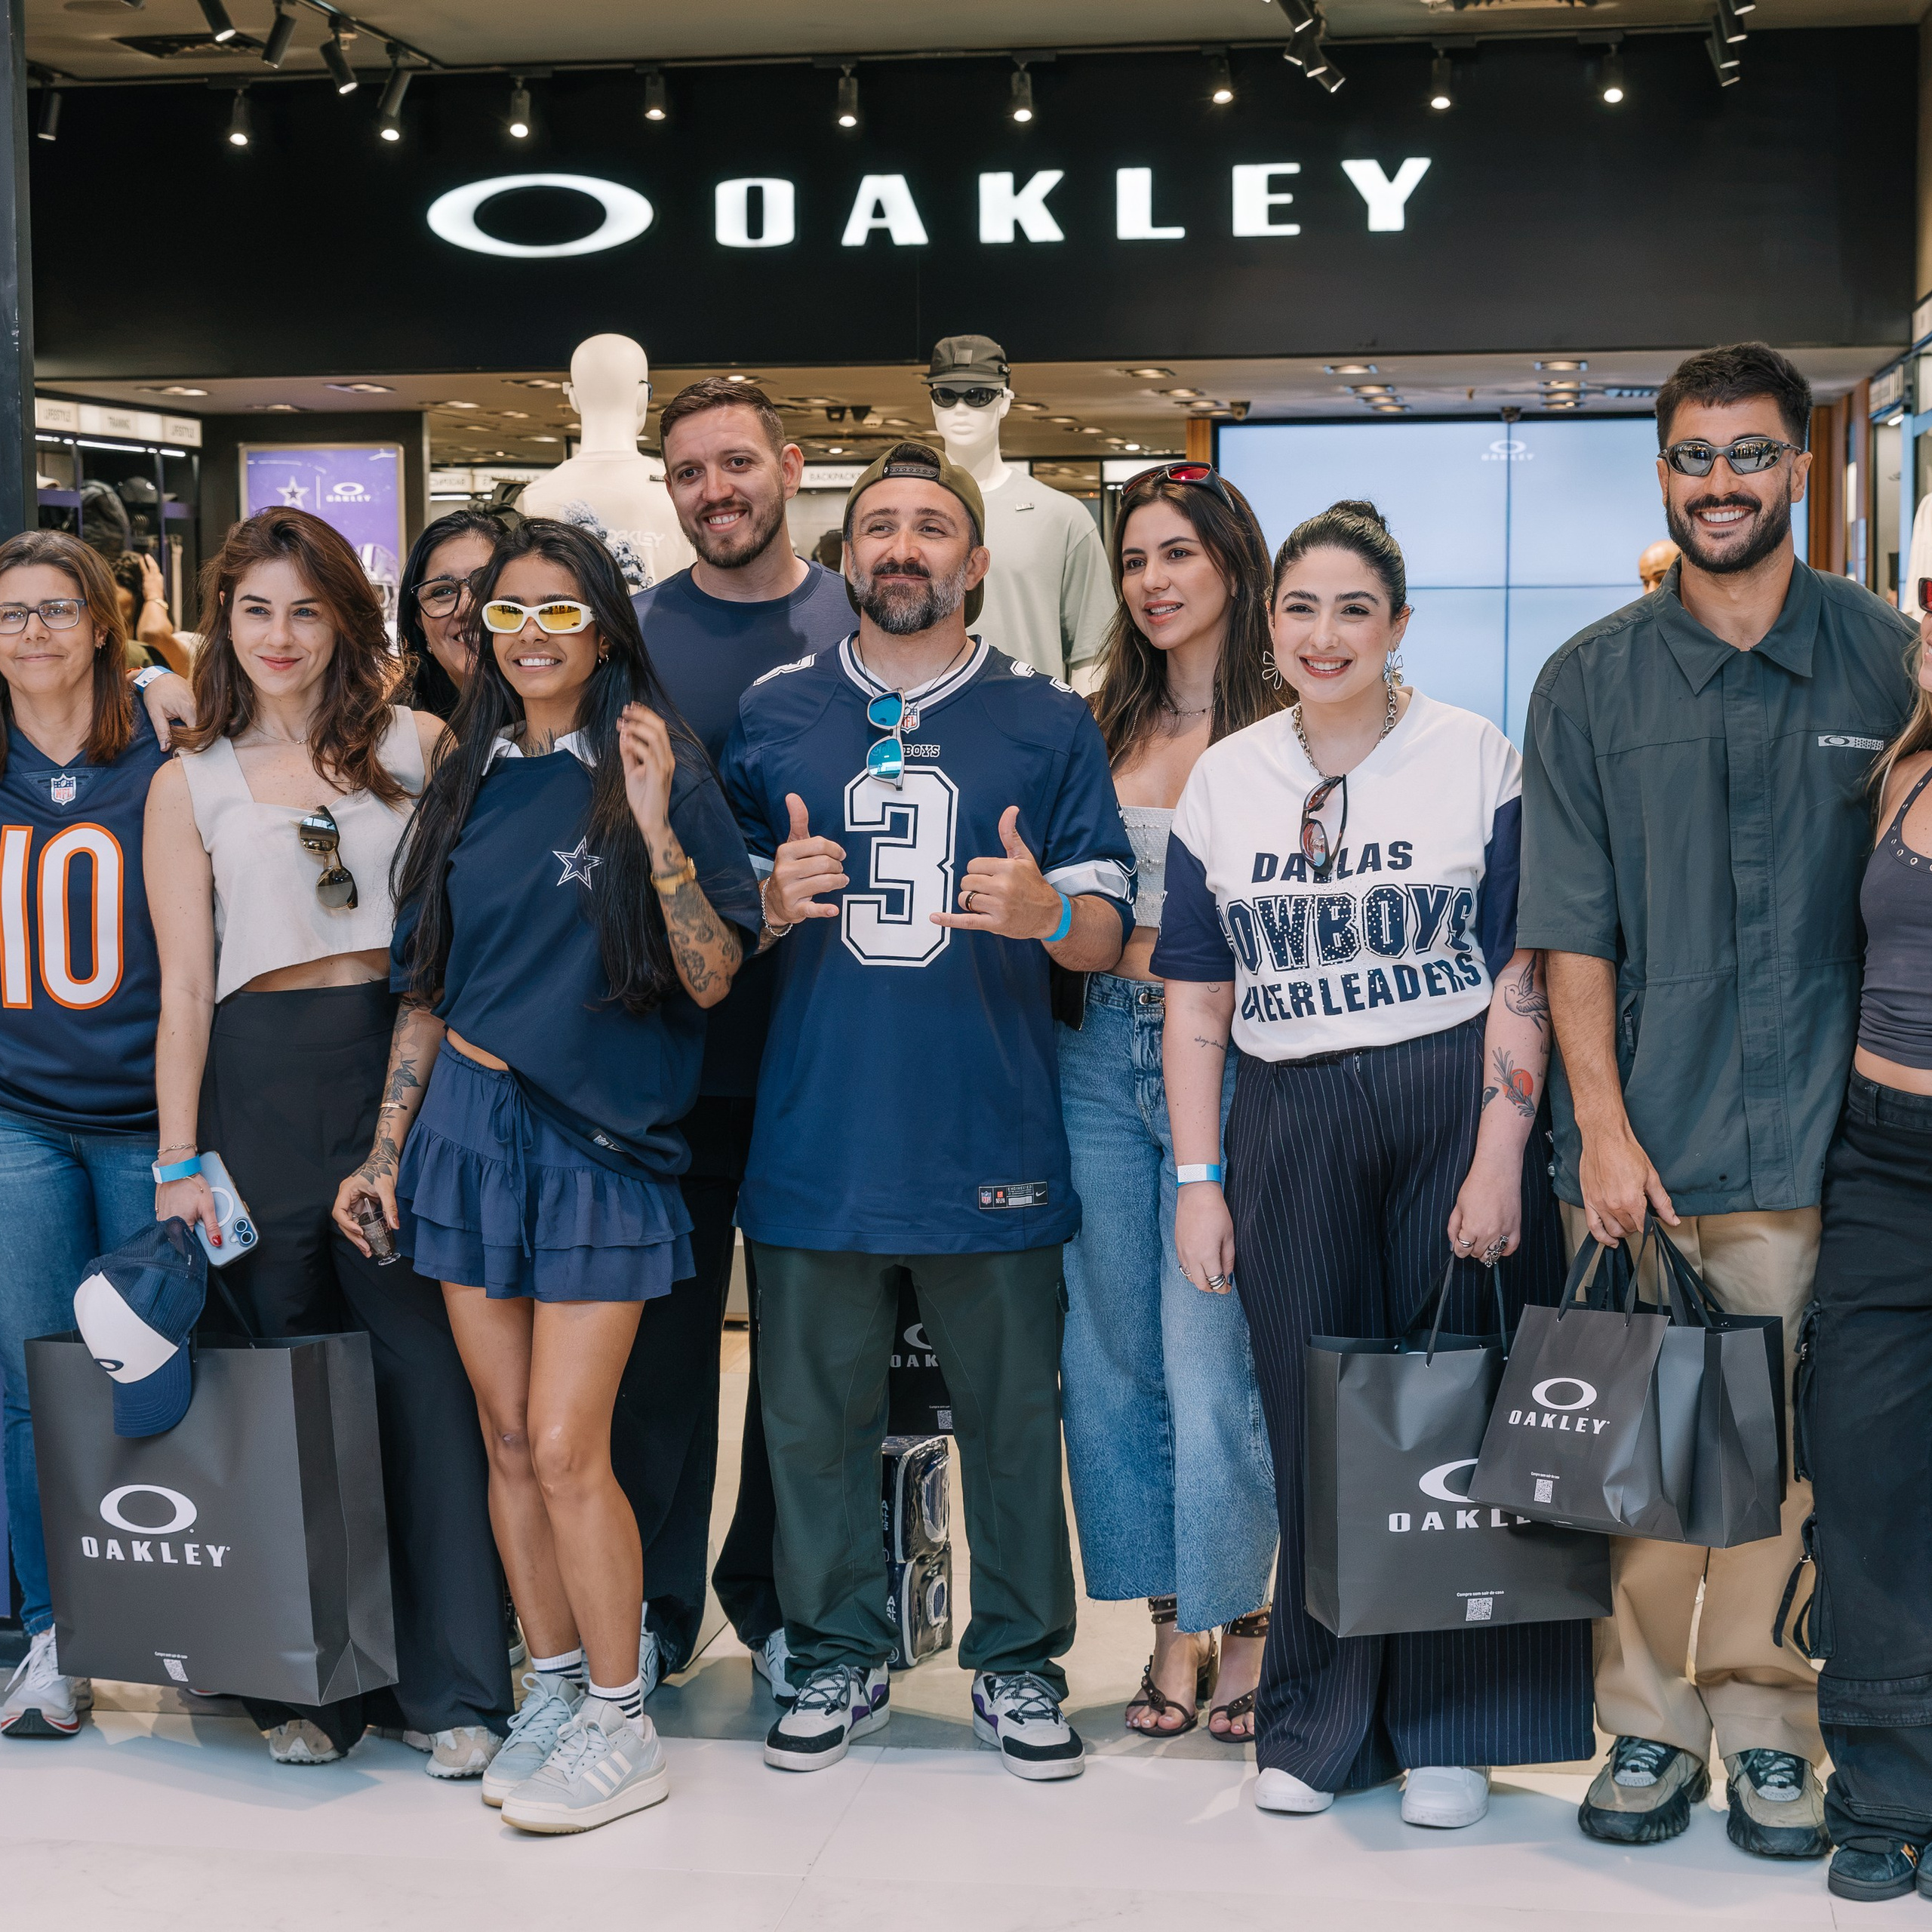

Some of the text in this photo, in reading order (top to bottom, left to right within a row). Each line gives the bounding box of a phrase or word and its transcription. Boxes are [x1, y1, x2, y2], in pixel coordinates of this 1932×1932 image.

[715, 157, 1432, 248] OAKLEY
[903, 744, 940, 758] BOYS
[55, 788, 72, 799] NFL
[841, 764, 959, 968] 3
[0, 822, 125, 1010] 10
[1217, 883, 1475, 975] OWBOYS
[891, 1354, 939, 1367] OAK
[1508, 1410, 1607, 1435] OAKLEY
[1389, 1509, 1531, 1533] OAKL
[82, 1536, 227, 1567] OAKLEY
